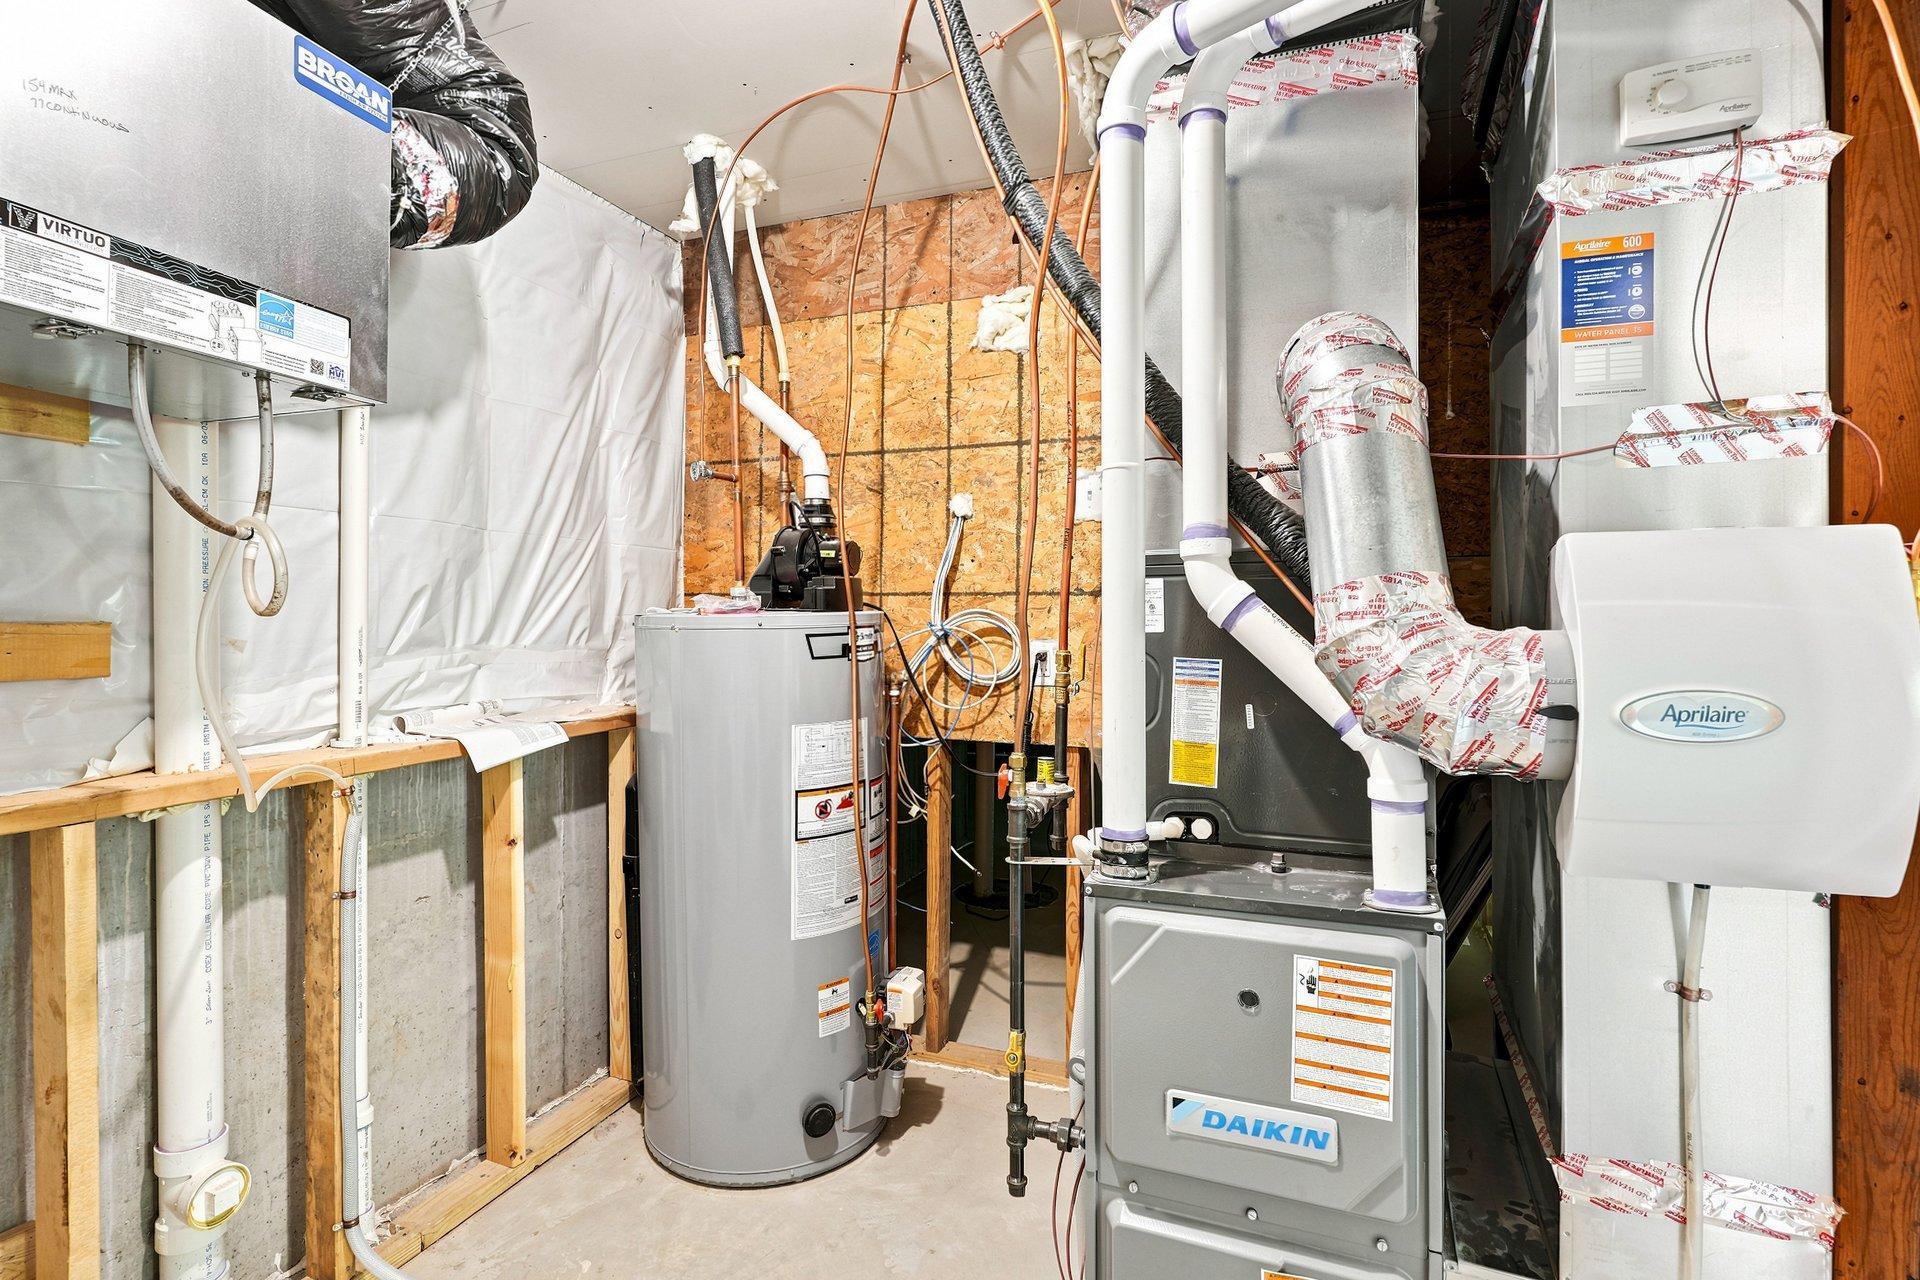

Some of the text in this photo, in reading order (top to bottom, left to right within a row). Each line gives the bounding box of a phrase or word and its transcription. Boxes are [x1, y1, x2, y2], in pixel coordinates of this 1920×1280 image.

[22, 78, 78, 101] 154 MAX
[298, 45, 390, 116] BROAN
[43, 217, 105, 247] VIRTUO
[1573, 236, 1642, 252] Aprilaire 600
[1574, 329, 1603, 339] WATER
[1604, 326, 1630, 337] PANEL
[1659, 704, 1747, 729] Aprilaire
[203, 814, 211, 828] IPS
[203, 832, 211, 852] PIPE
[1202, 1109, 1330, 1150] DAIKIN
